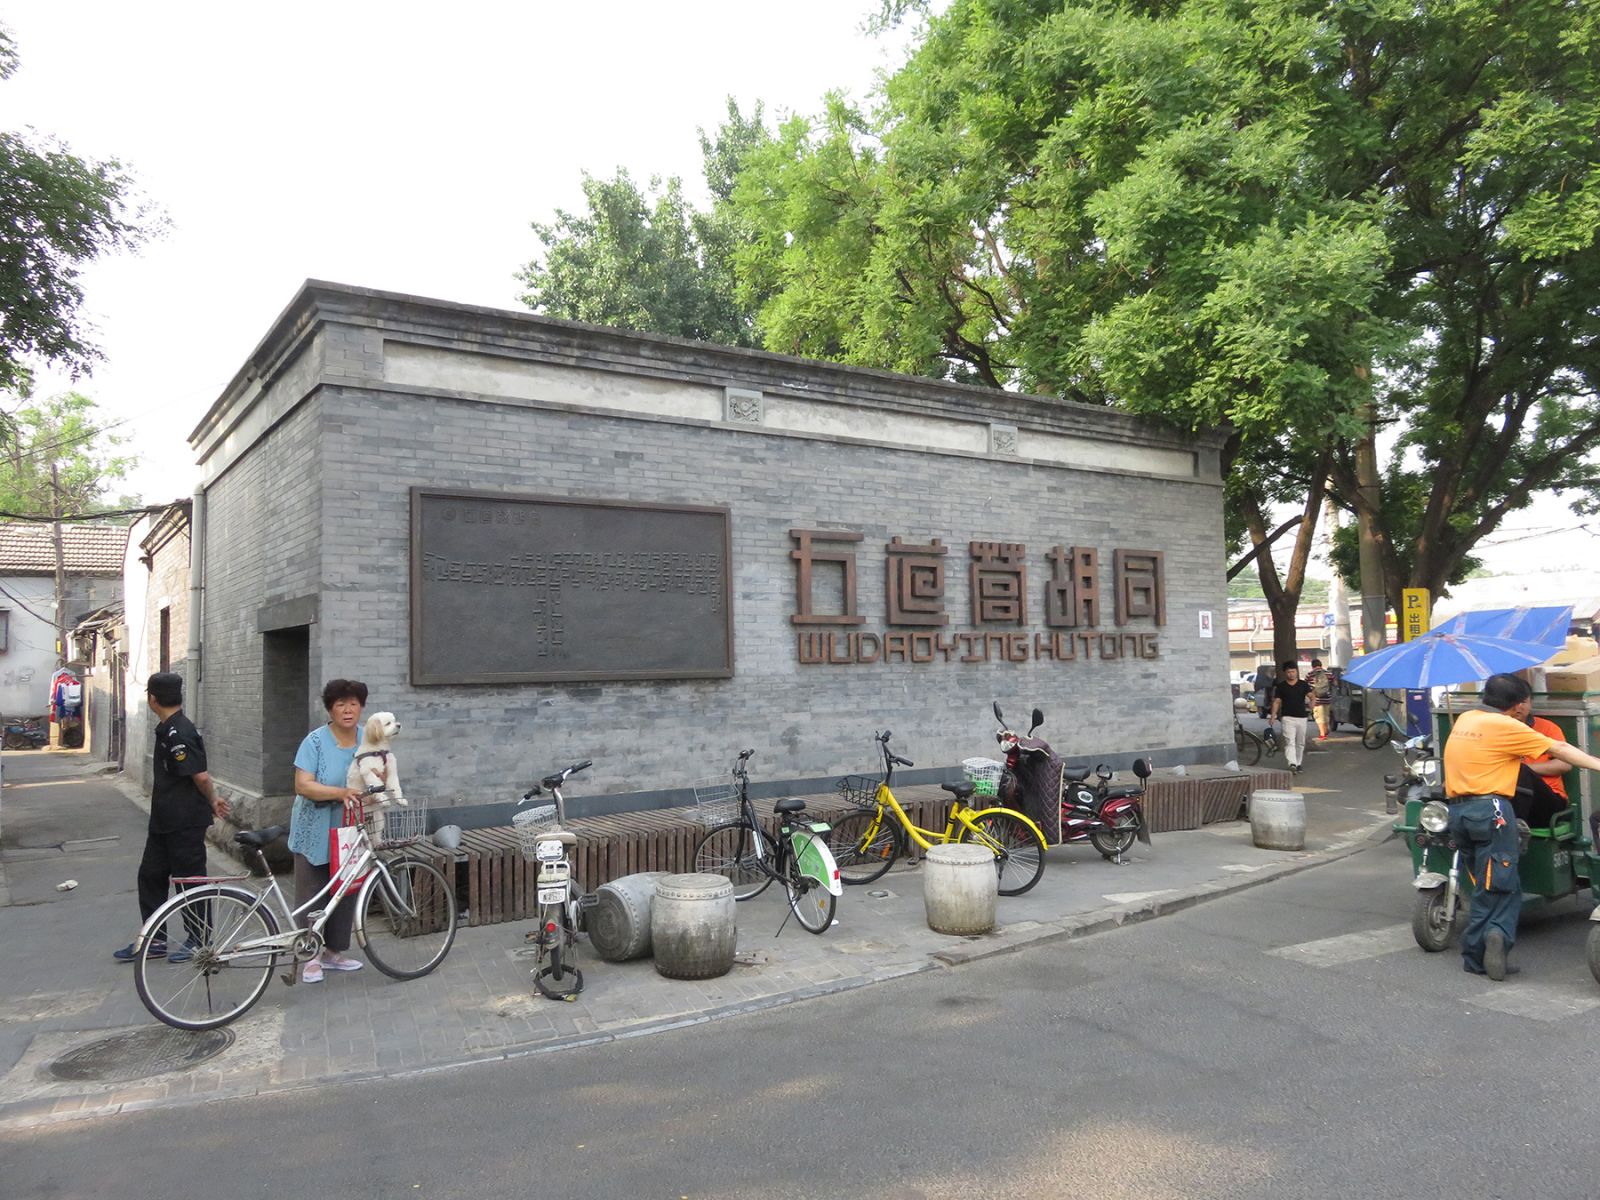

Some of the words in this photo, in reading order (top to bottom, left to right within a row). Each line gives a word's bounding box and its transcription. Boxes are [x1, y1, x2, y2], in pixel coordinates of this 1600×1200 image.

[1407, 595, 1419, 608] P
[797, 631, 1029, 665] WUDAOYING
[1035, 632, 1161, 662] HUTONG
